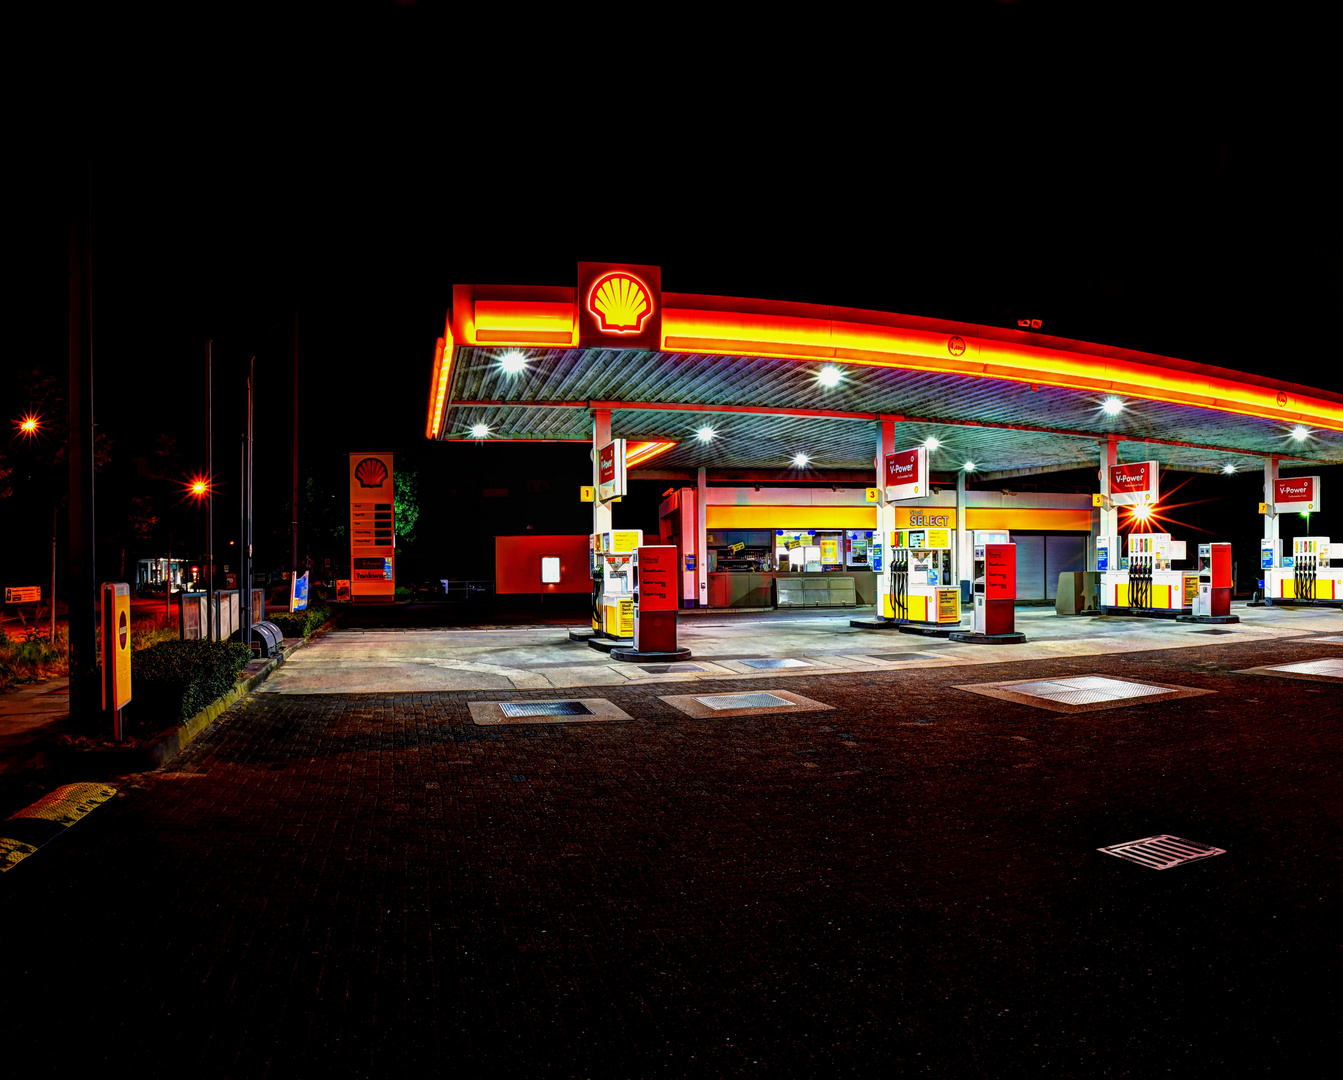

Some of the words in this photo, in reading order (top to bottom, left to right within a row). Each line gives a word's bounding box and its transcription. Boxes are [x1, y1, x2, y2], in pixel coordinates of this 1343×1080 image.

[890, 464, 913, 474] V-Power
[1116, 475, 1143, 483] V-Power
[910, 515, 949, 526] SELECT
